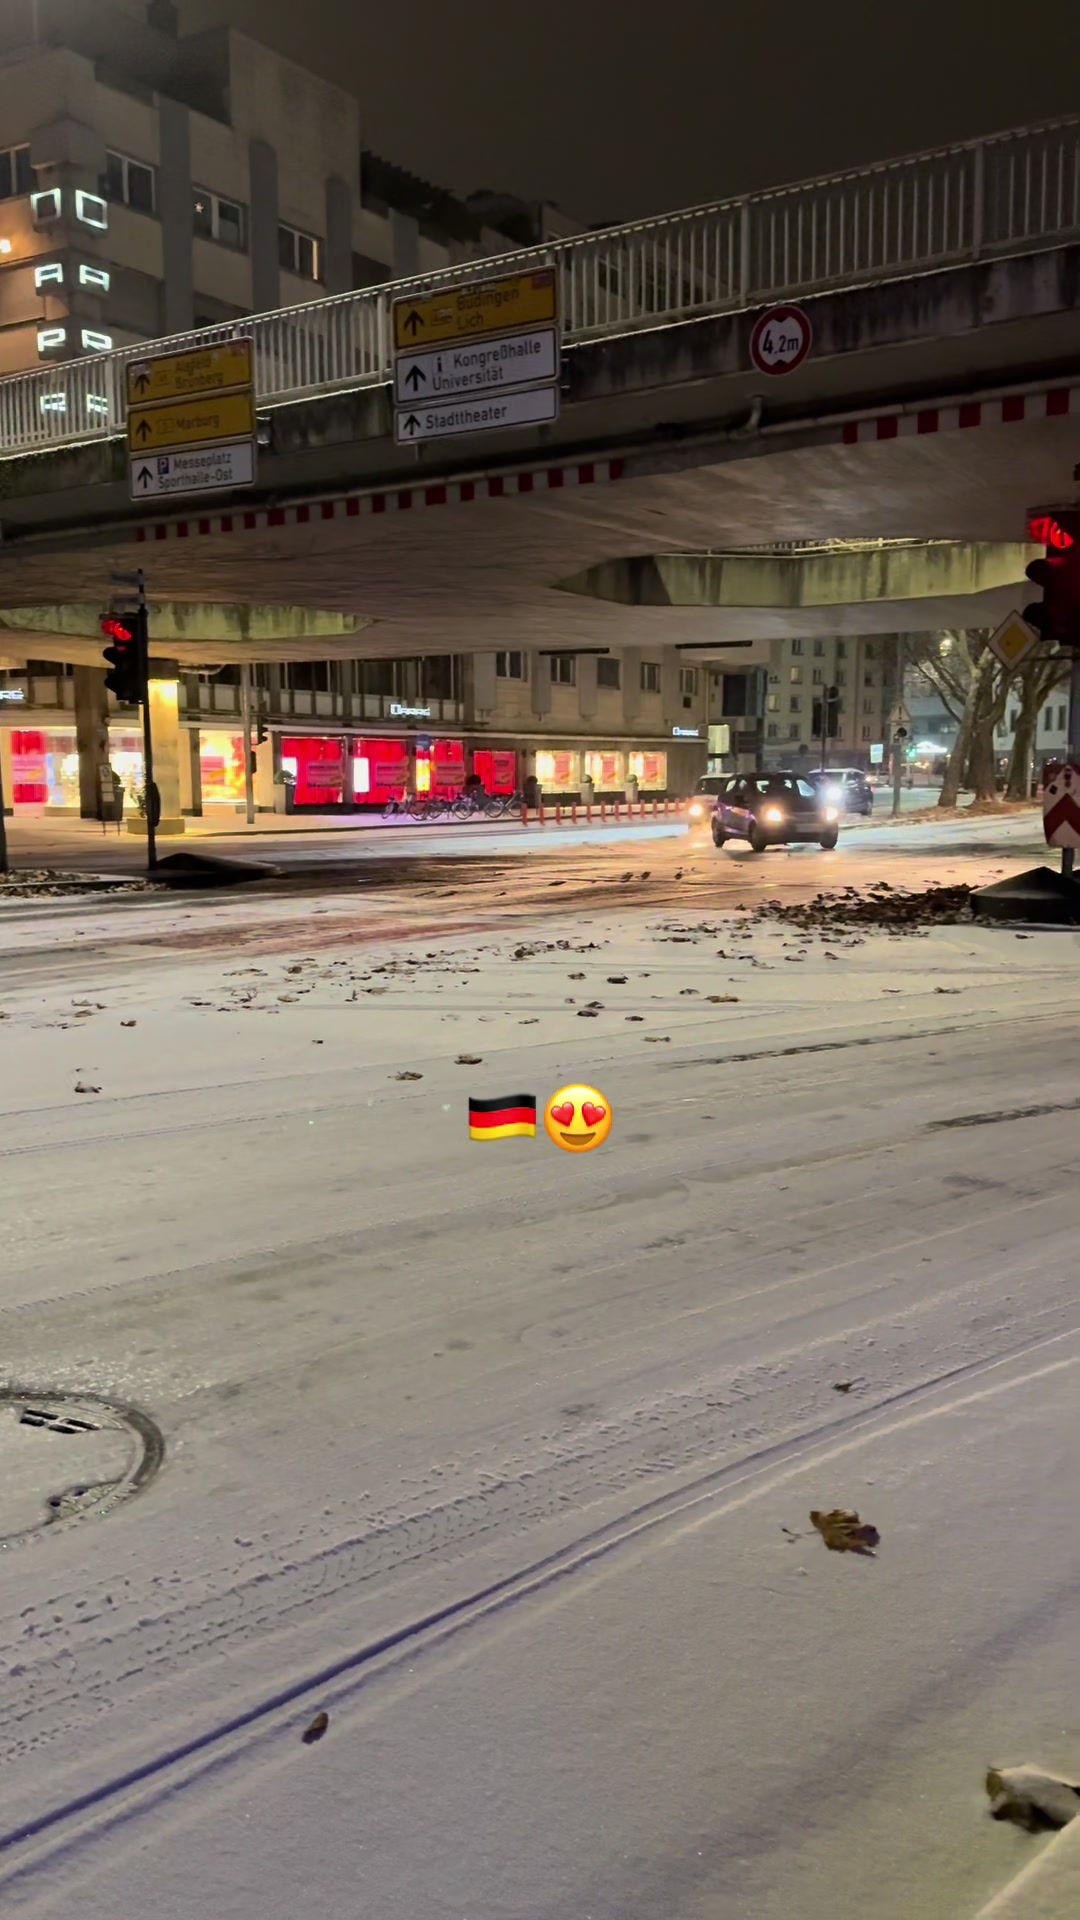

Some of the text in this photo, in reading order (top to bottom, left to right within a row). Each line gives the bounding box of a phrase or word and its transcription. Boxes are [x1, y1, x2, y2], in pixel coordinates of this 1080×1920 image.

[456, 312, 485, 331] Lich
[453, 340, 542, 369] Kongreßhalle
[431, 366, 504, 391] Universität
[425, 405, 508, 430] Stadttheater
[173, 452, 232, 471] Messeplatz
[158, 468, 233, 490] Sporthalle-Ost
